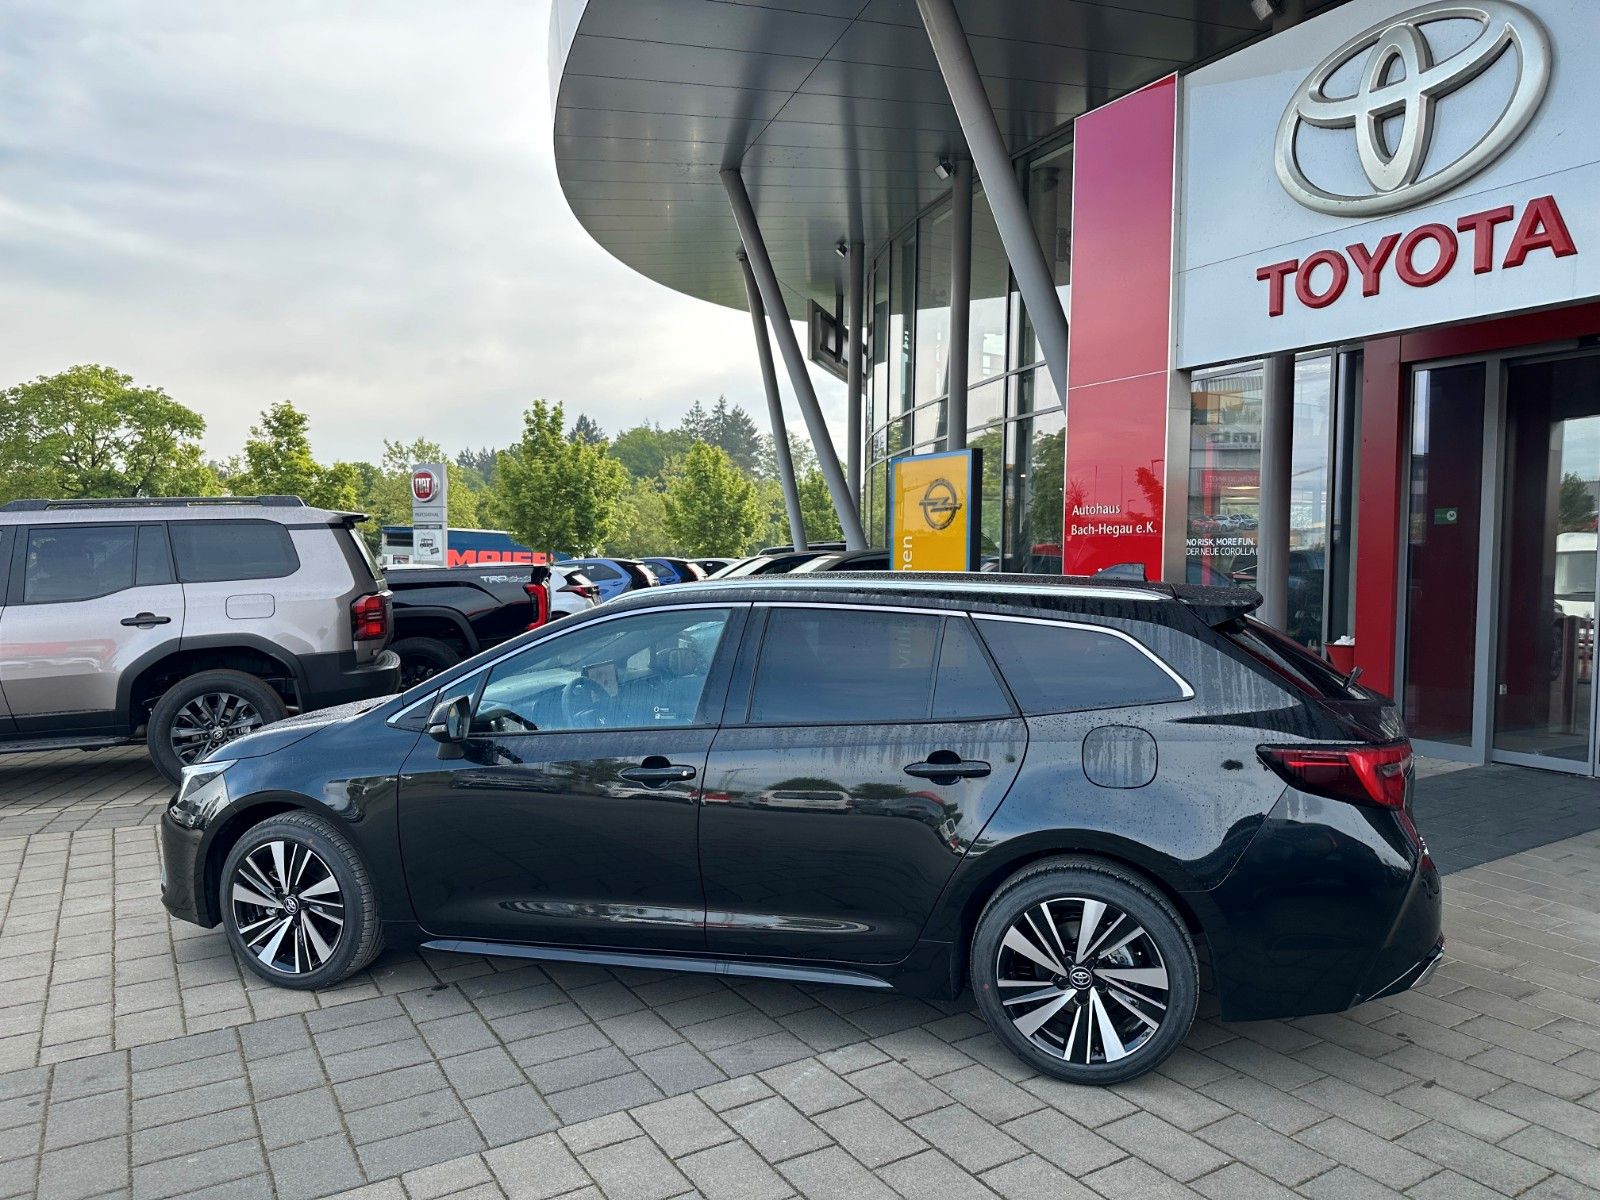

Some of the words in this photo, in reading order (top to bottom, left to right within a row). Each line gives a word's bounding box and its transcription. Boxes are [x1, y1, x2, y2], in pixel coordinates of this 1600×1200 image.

[1256, 194, 1578, 317] TOYOTA
[415, 477, 431, 494] FIAT
[1072, 503, 1120, 516] Autohaus
[1071, 523, 1132, 538] Bach-Hegau
[1136, 521, 1157, 534] e.K.
[1186, 538, 1197, 546] NO
[1197, 538, 1215, 547] RISK,
[1216, 537, 1237, 546] MORE
[1237, 537, 1256, 546] FUN.
[1200, 547, 1219, 556] NEUE
[1220, 547, 1255, 556] COROLLA
[480, 575, 507, 584] TRD
